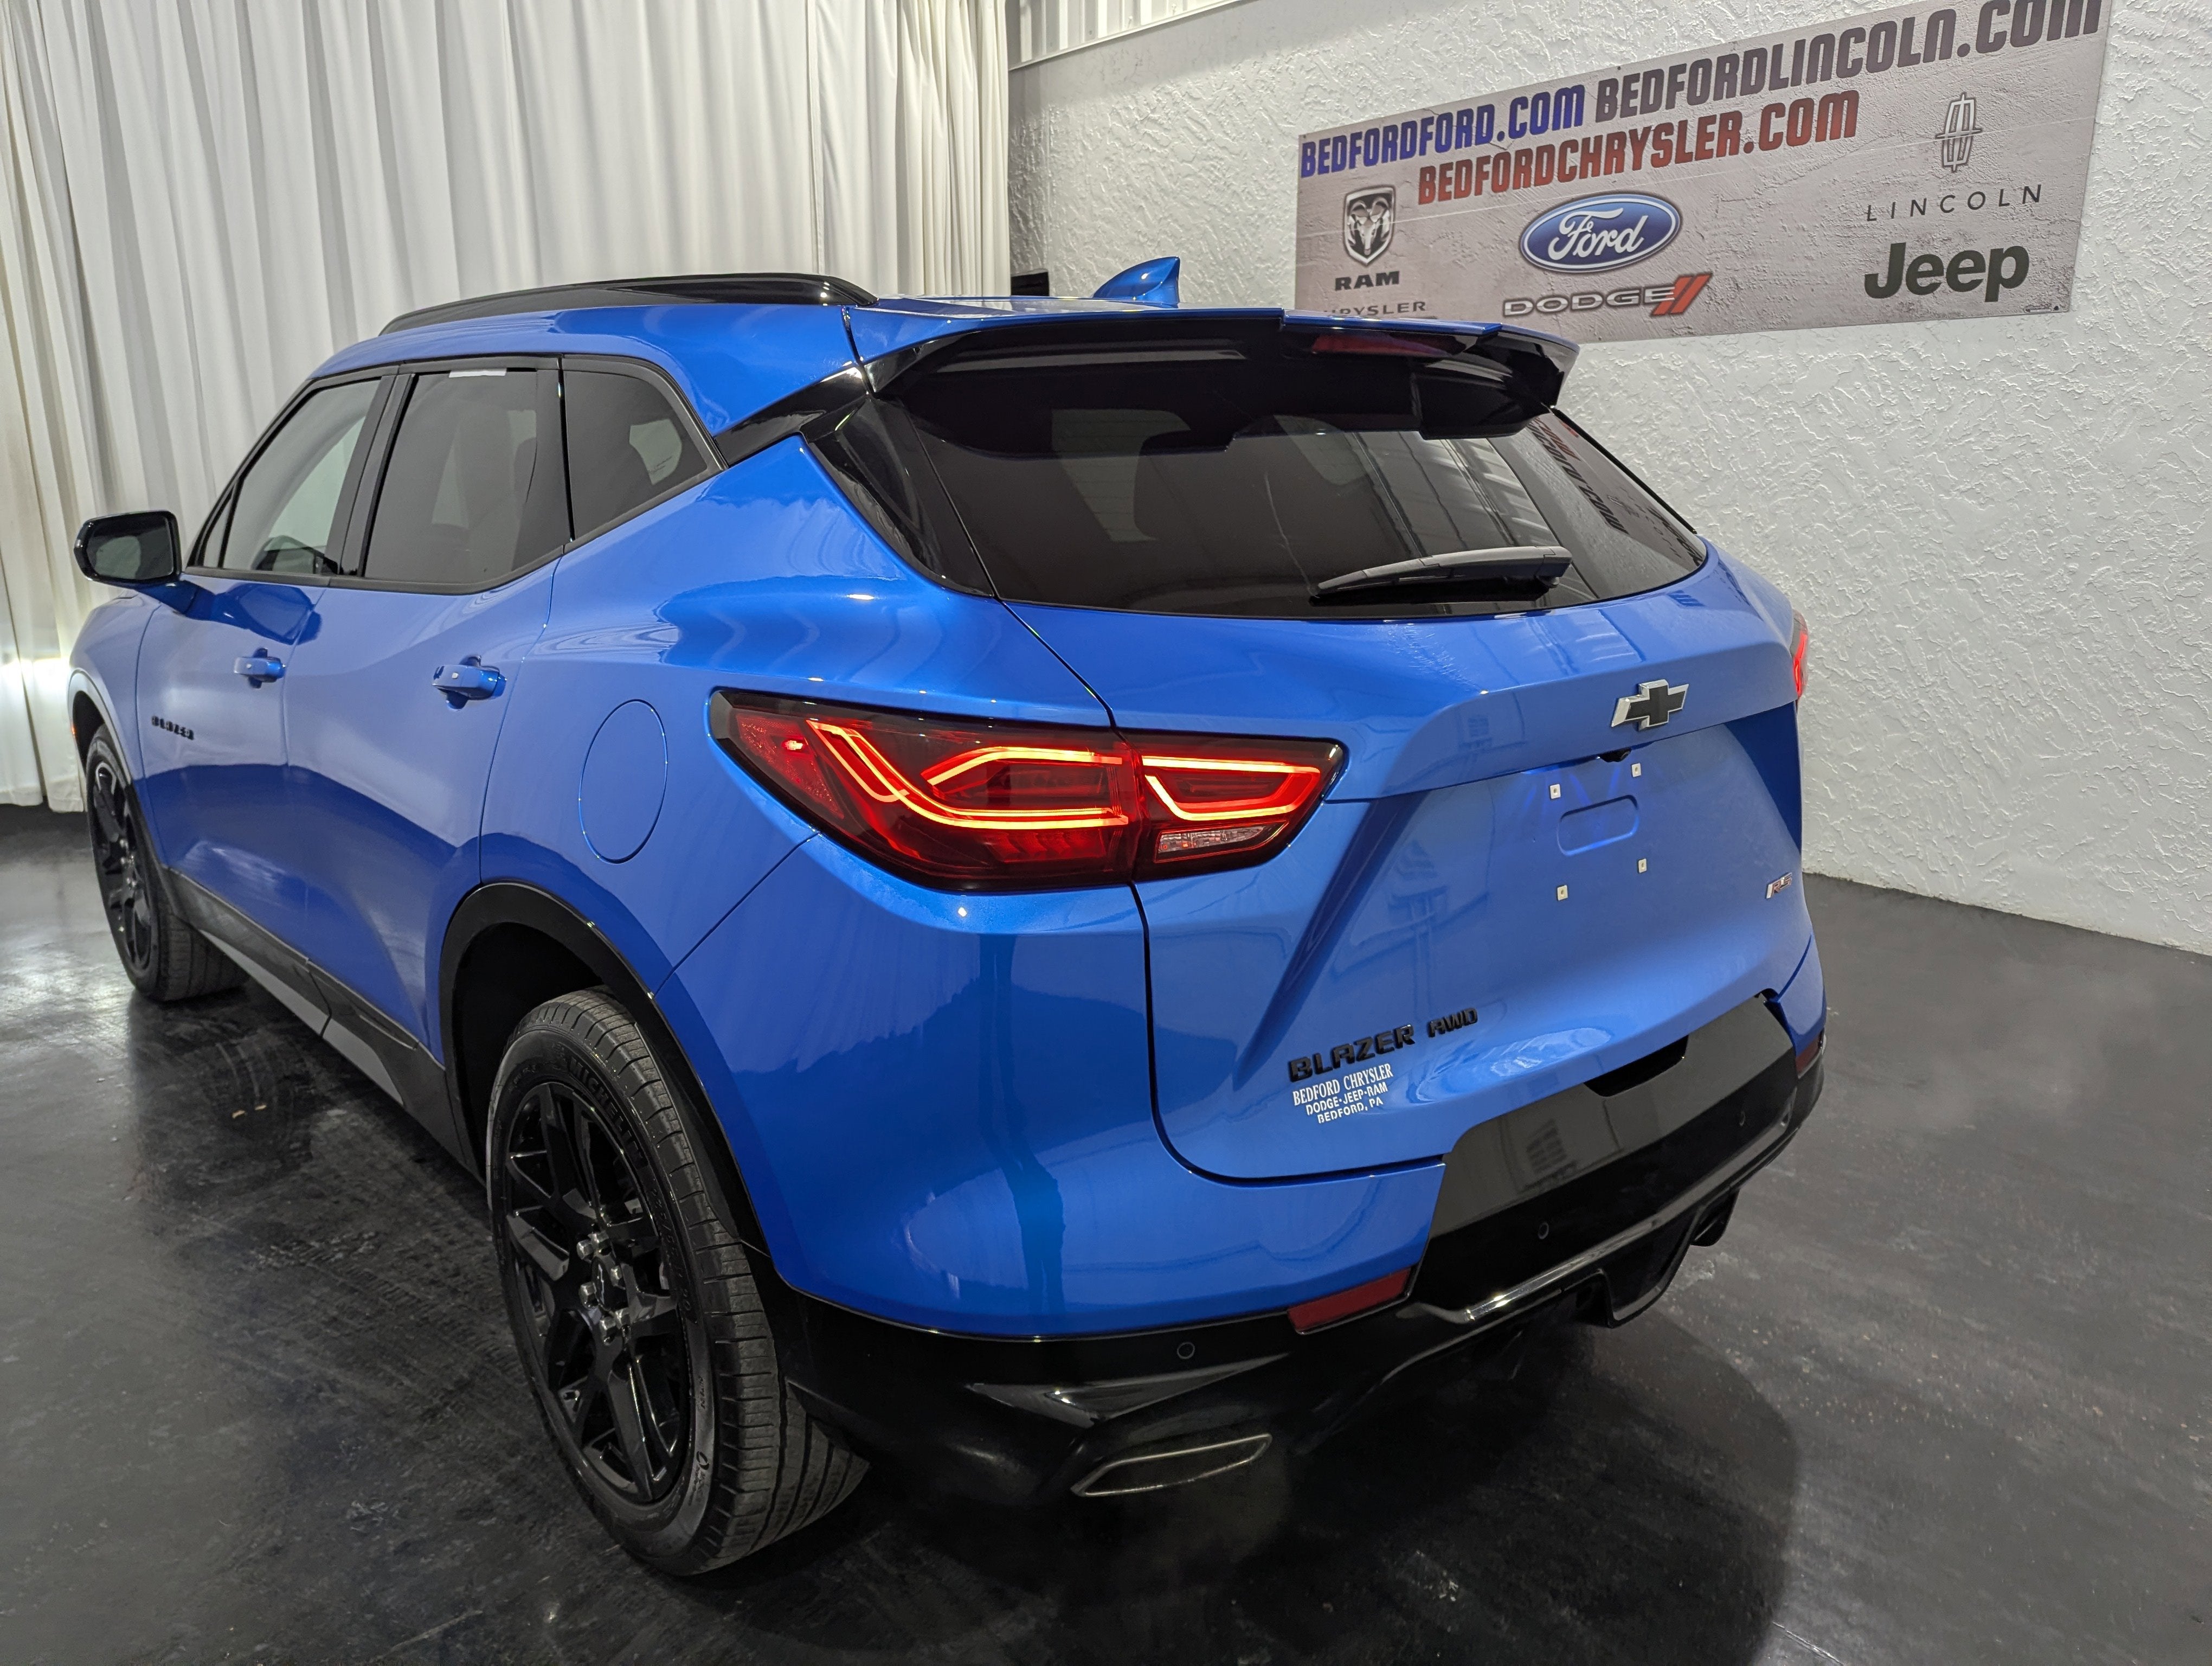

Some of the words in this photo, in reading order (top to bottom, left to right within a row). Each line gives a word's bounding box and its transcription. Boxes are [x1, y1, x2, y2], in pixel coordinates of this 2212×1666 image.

[1301, 85, 1585, 178] BEDFORDFORD.COM
[1595, 0, 2102, 123] BEDFORDLINCOLN.COM
[1418, 89, 1860, 206] BEDFORDCHRYSLER.COM
[1866, 184, 2043, 222] LINCOLN
[1547, 207, 1645, 262] Ford
[1334, 271, 1400, 292] RAM
[1864, 242, 2030, 303] Jeep
[1503, 285, 1677, 317] DODGE
[1766, 872, 1792, 899] RS
[1288, 1023, 1416, 1082] BLAZER
[1426, 1008, 1478, 1038] AWD
[1293, 1079, 1341, 1106] BEDFORD
[1343, 1063, 1394, 1091] CHRYSLER
[1317, 1102, 1368, 1124] BEDFORD,
[1369, 1096, 1384, 1108] PA
